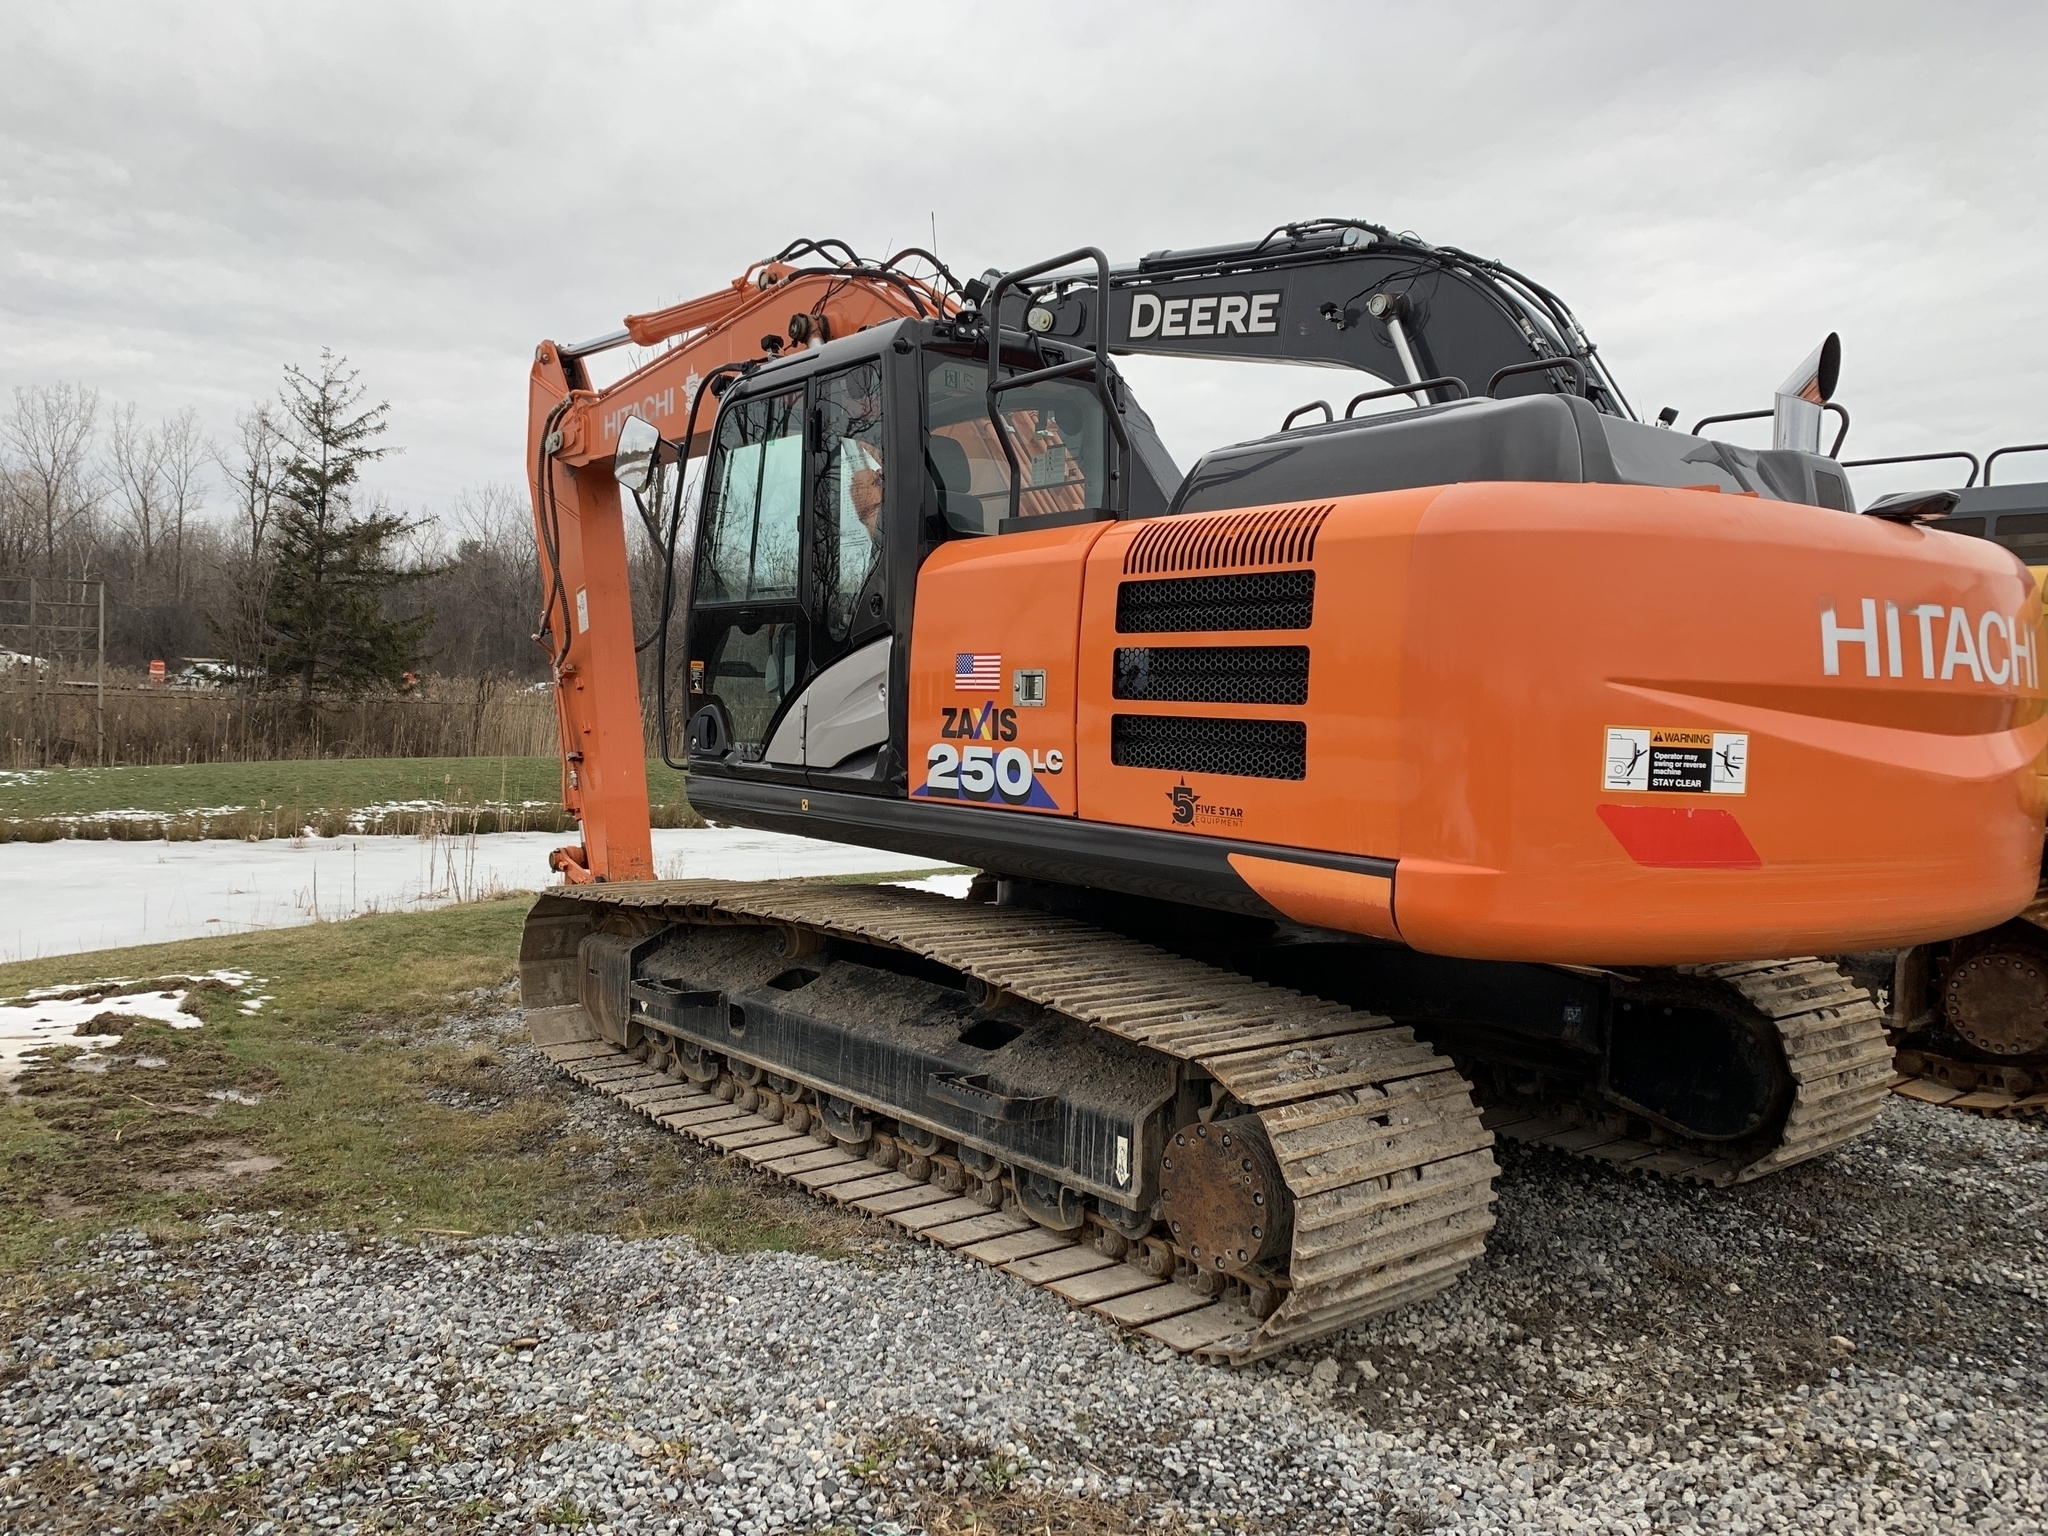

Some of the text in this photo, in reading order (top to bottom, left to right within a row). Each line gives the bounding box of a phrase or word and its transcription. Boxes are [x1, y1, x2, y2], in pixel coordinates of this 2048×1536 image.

[1129, 293, 1280, 338] DEERE
[604, 387, 675, 440] HITACHI
[1818, 594, 2040, 690] HITACHI
[941, 700, 1018, 742] ZAXIS
[1664, 732, 1711, 744] WARNING
[1654, 752, 1699, 762] Operator may
[1652, 778, 1702, 788] STAY CLEAR
[1195, 804, 1243, 818] FIVE STAR
[1195, 815, 1243, 828] EQUIPMENT
